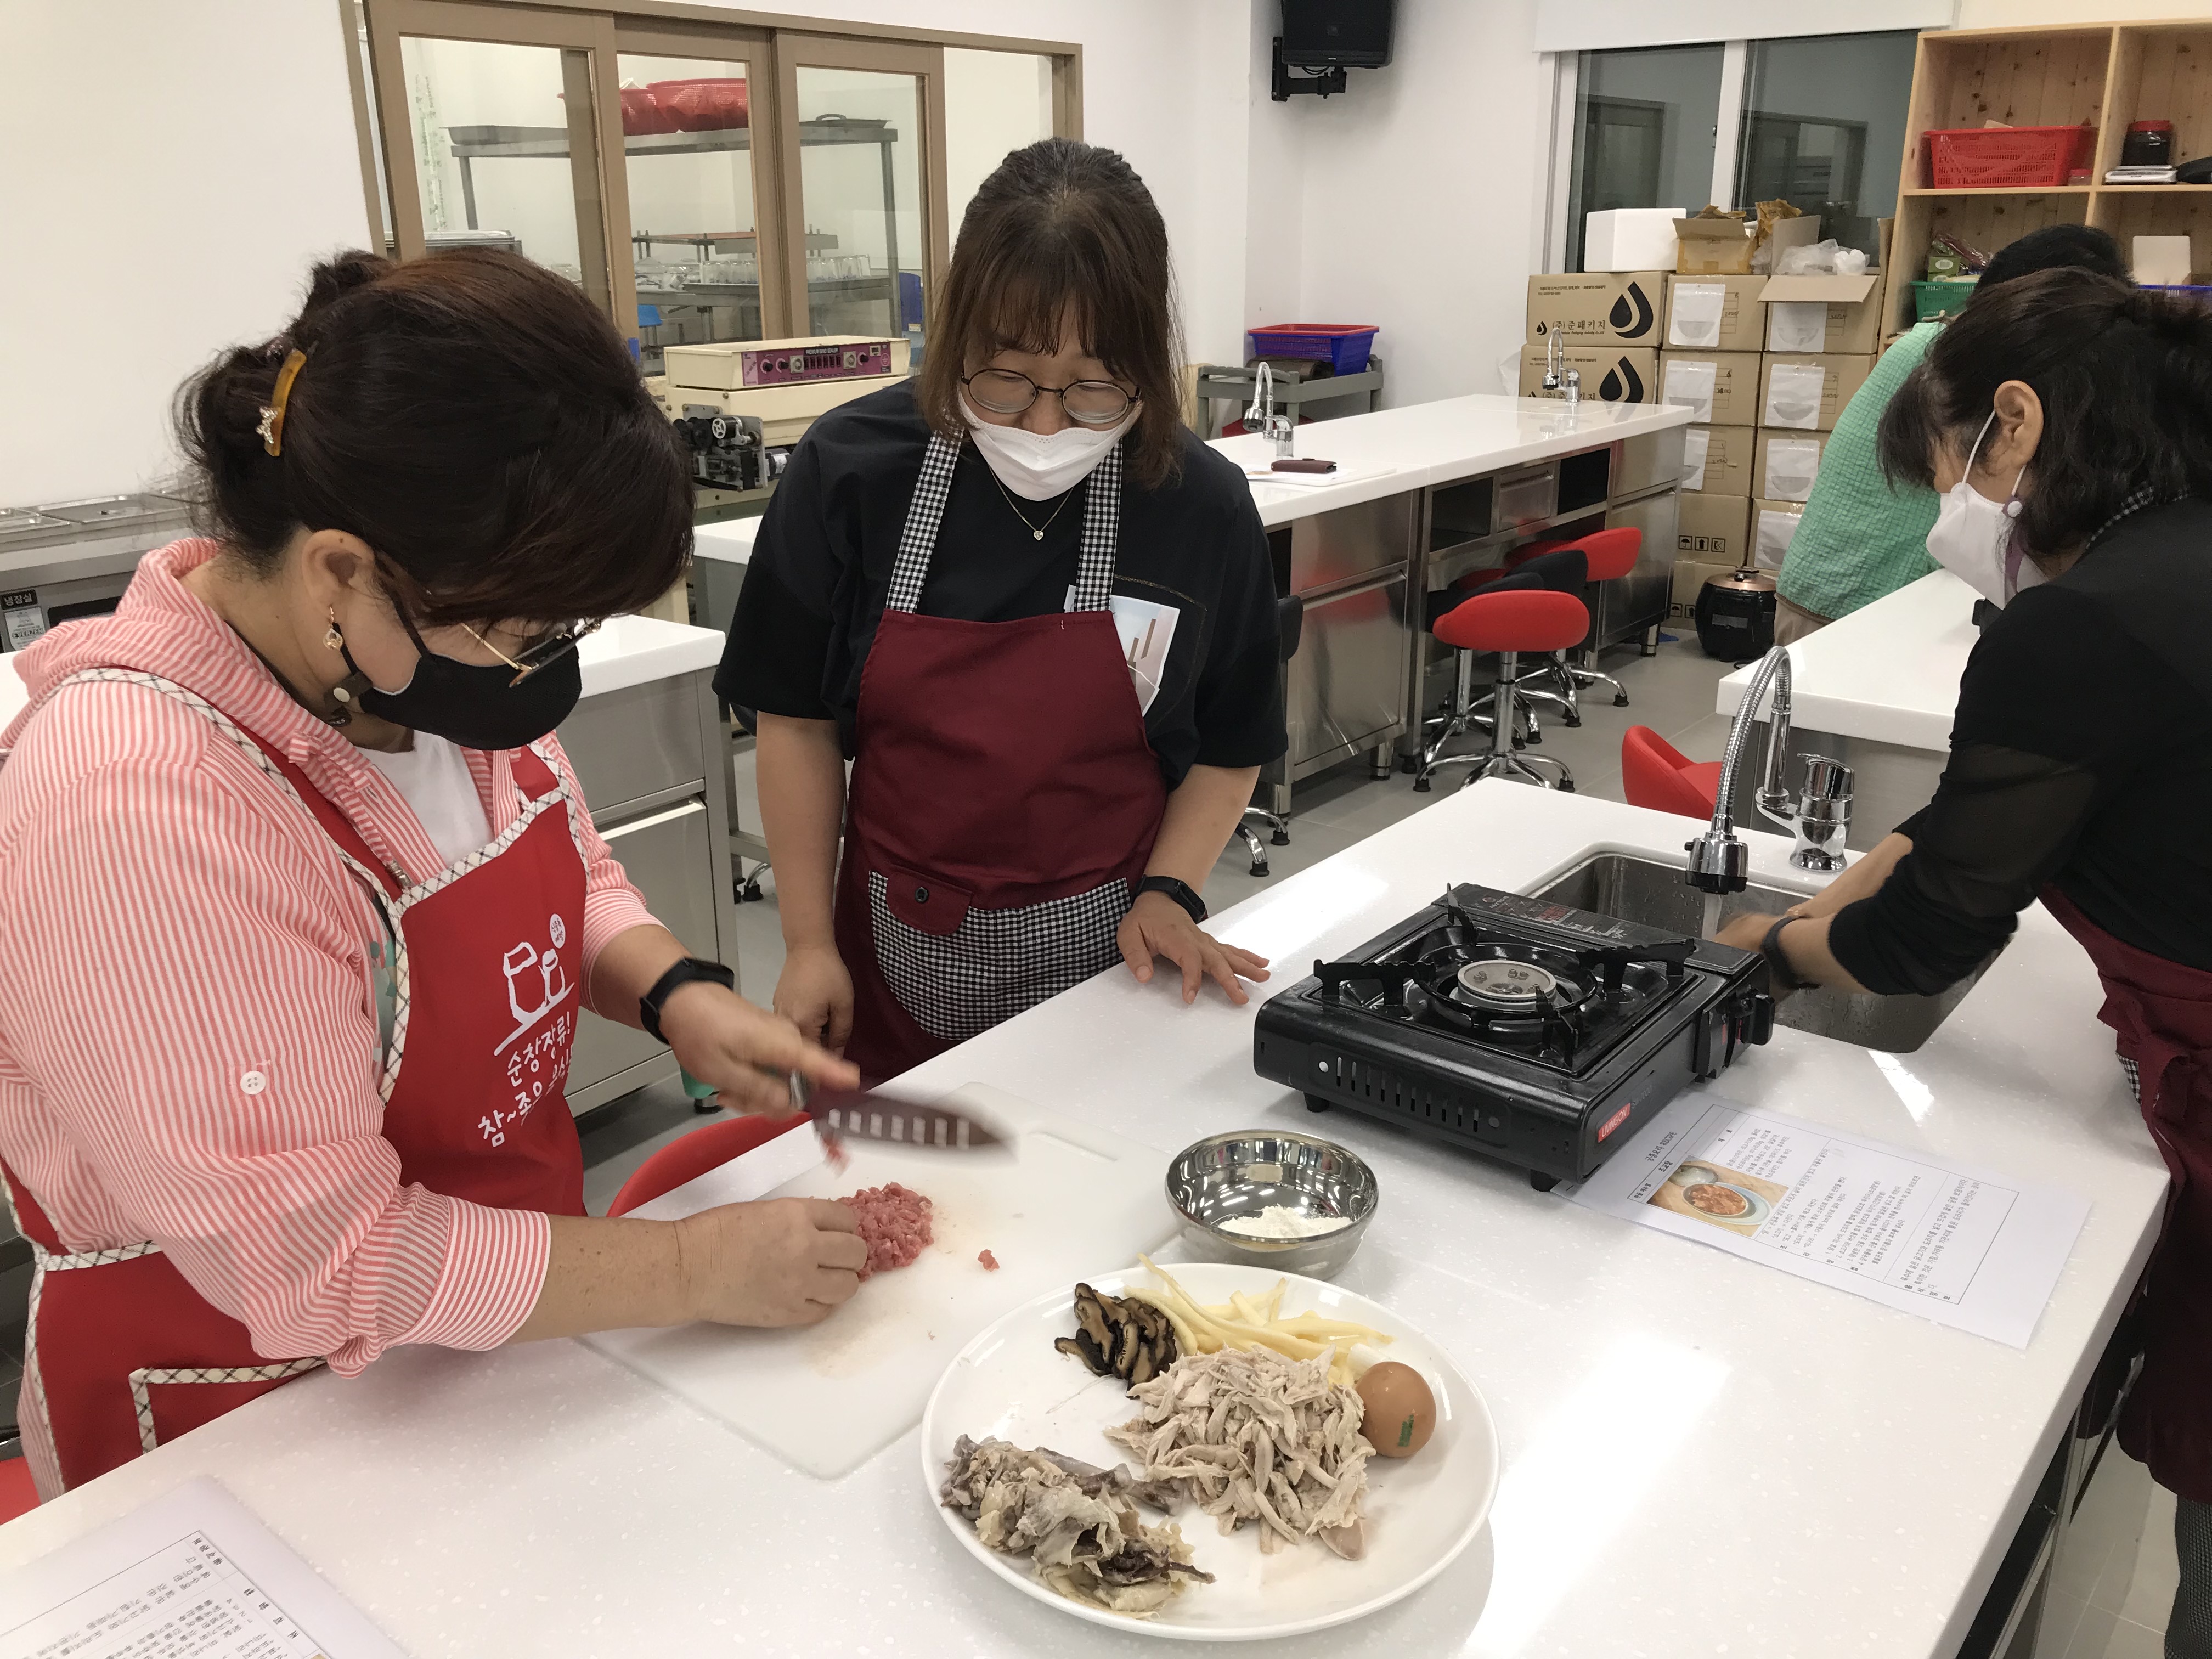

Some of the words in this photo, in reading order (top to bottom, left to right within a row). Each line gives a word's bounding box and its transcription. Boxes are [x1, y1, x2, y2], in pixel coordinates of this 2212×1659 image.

[4, 593, 33, 606] 냉장실
[12, 629, 44, 639] EVERZEN
[507, 1011, 571, 1087] 순창장류!
[1659, 1131, 1677, 1145] RECIPE
